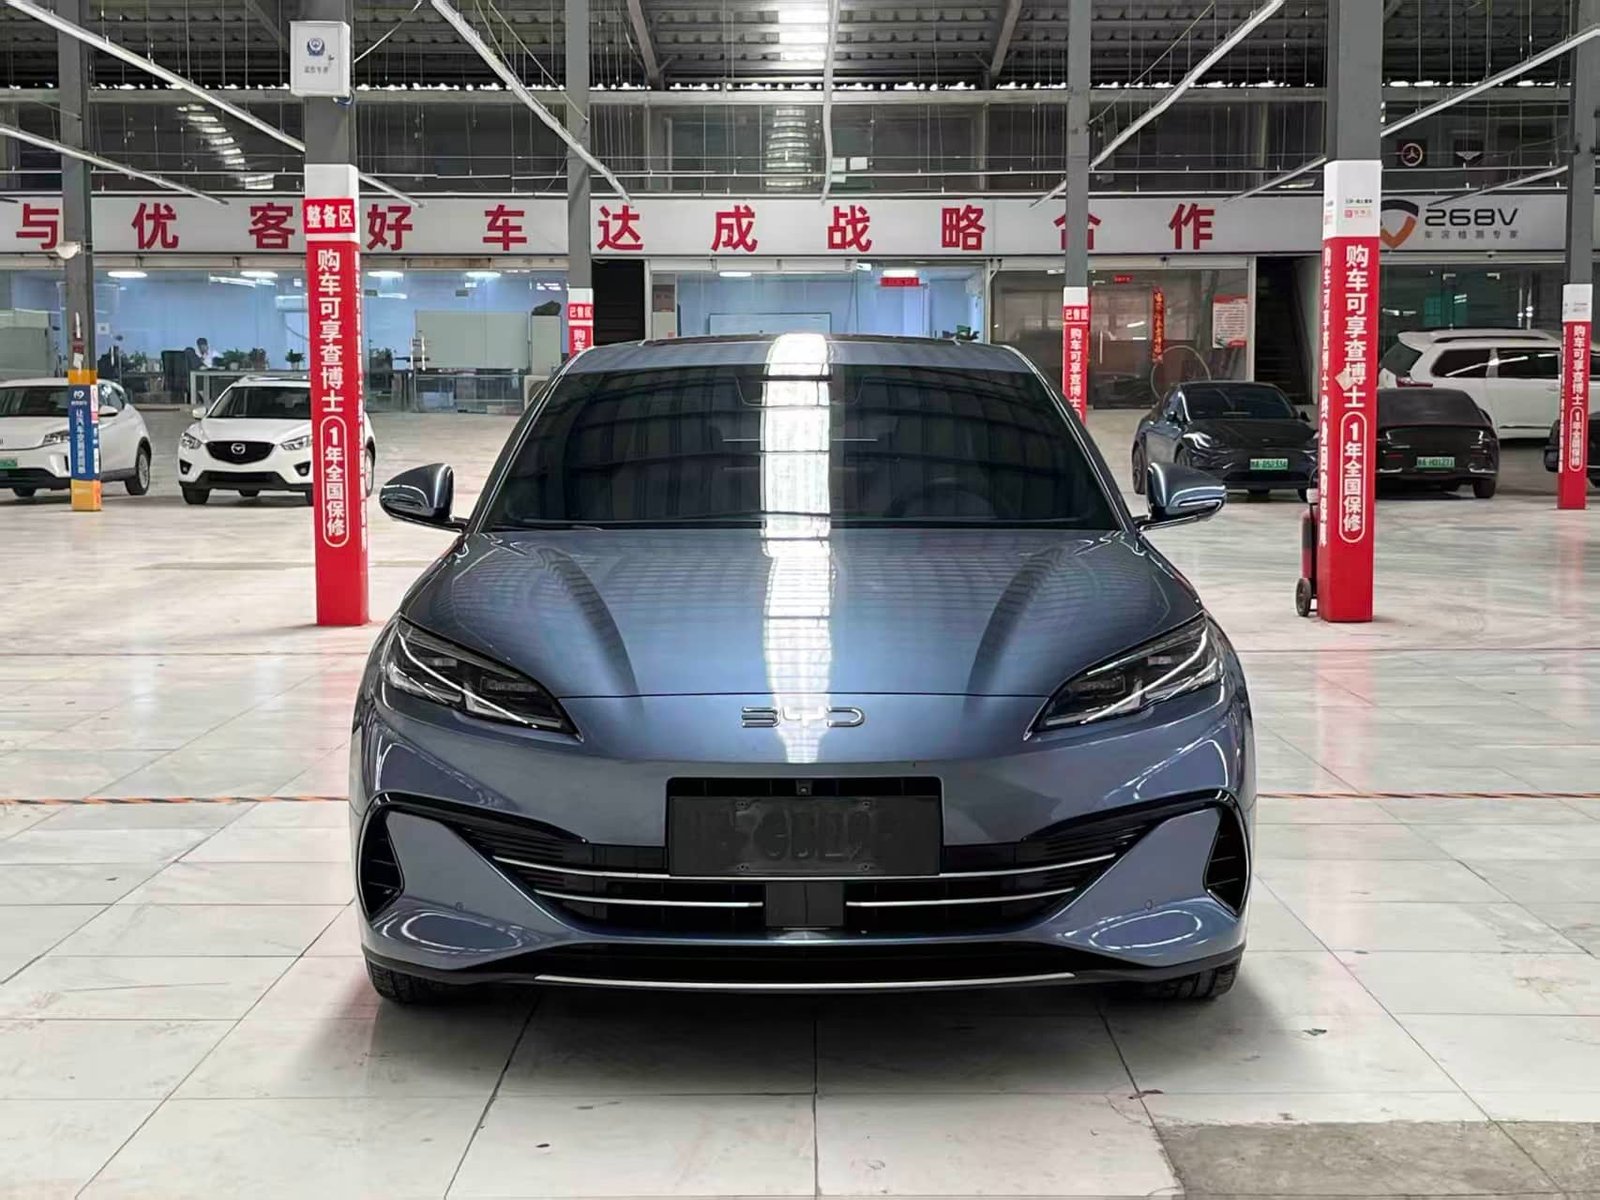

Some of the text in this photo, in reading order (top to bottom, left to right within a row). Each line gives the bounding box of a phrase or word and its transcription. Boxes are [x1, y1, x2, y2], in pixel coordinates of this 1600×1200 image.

[306, 204, 353, 229] 整备区
[1425, 208, 1519, 227] 268V
[317, 248, 345, 413] 购车可享查博士
[1343, 244, 1369, 408] 购车可享查博士
[325, 426, 346, 537] 1年全国保修
[1343, 421, 1363, 533] 1年全国保修
[741, 705, 866, 729] BYD
